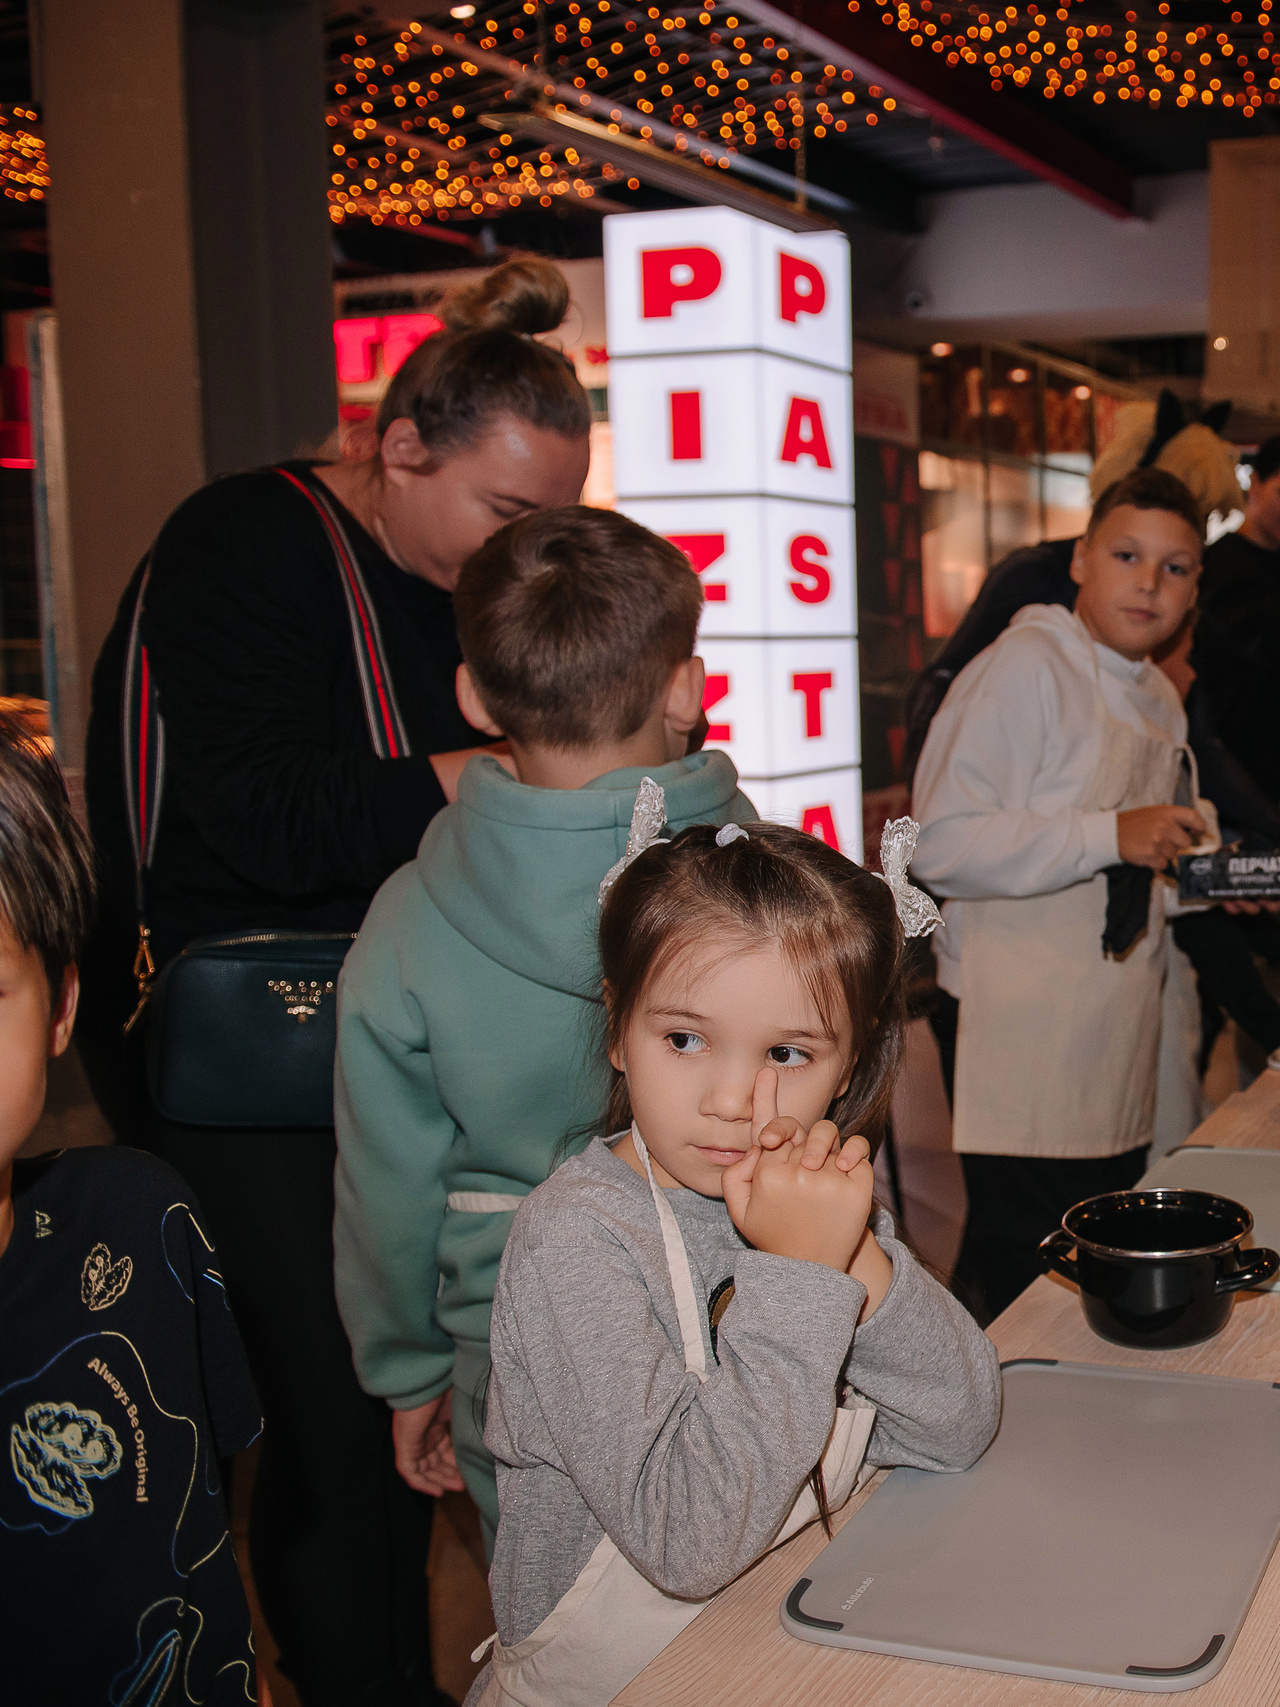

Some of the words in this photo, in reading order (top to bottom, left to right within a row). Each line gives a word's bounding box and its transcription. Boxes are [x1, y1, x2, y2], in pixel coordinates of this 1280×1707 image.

[87, 1357, 131, 1406] Always
[126, 1403, 140, 1428] Be
[134, 1429, 149, 1503] Original
[845, 1577, 875, 1606] Attribute
